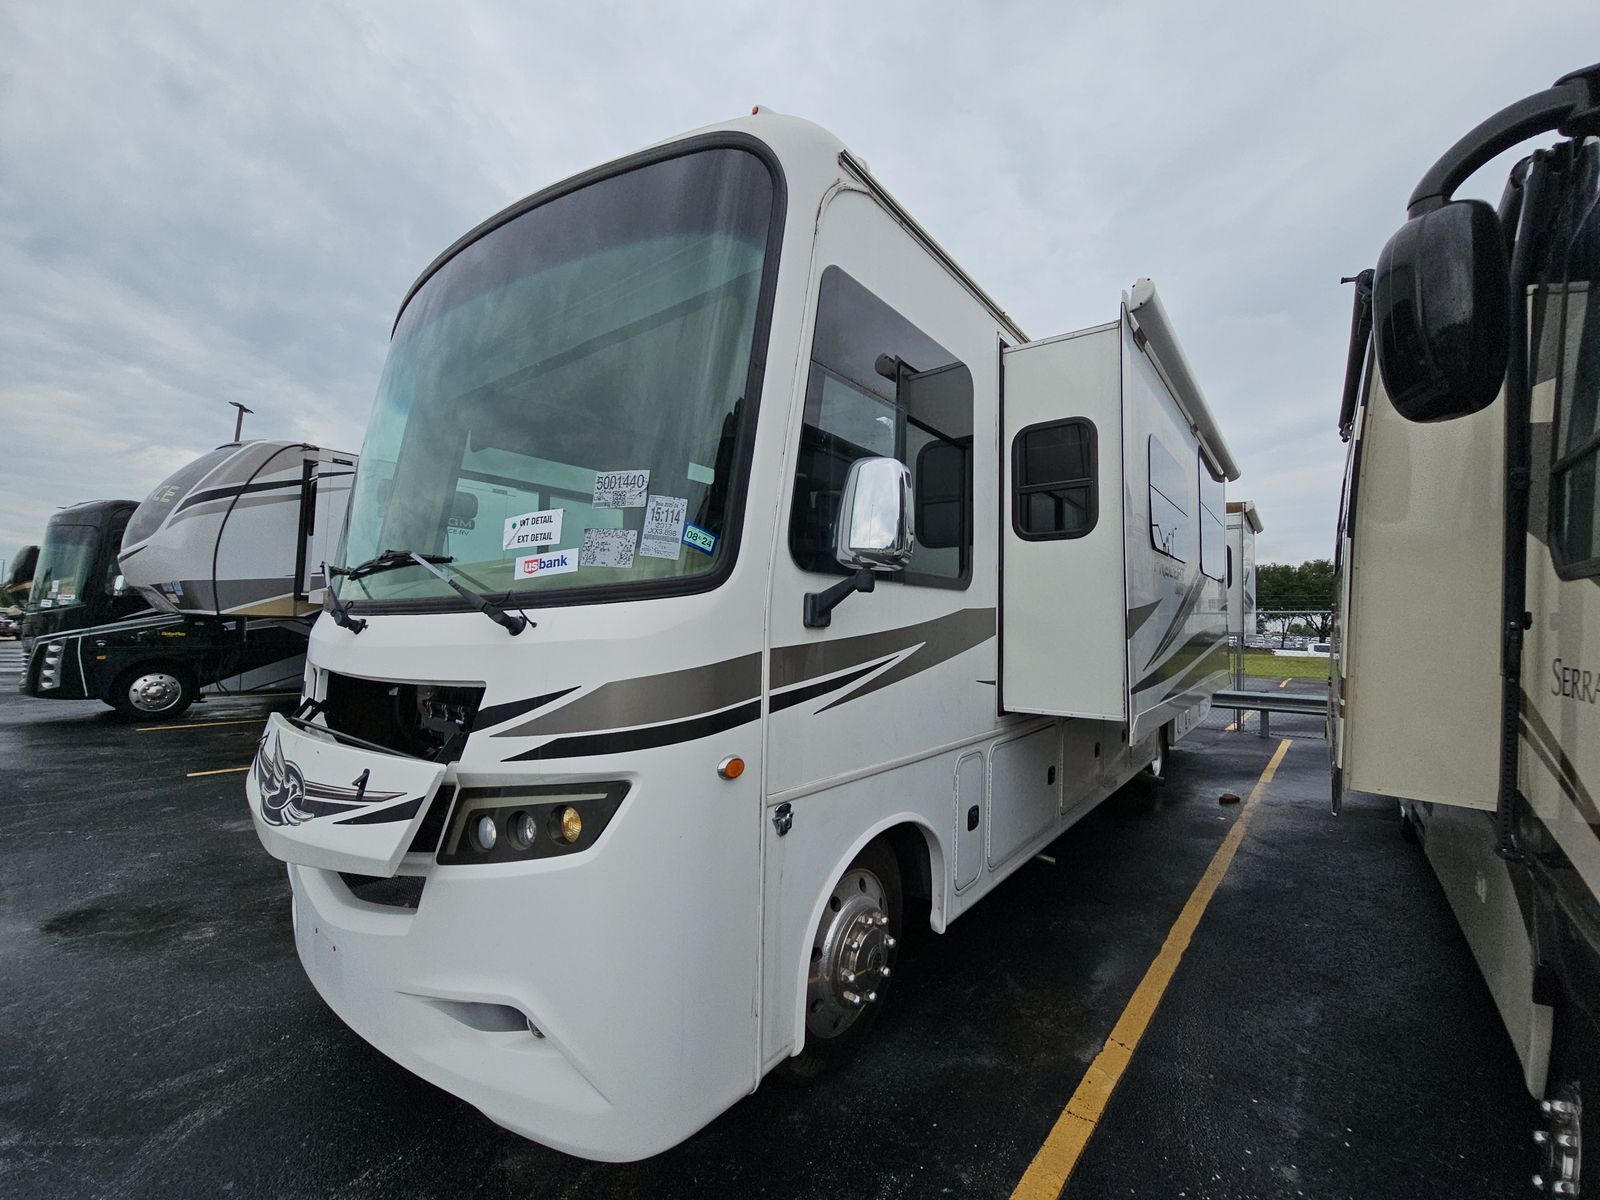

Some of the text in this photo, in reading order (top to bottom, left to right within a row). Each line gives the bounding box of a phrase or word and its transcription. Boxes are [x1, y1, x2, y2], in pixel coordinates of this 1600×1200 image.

[596, 474, 645, 490] 5001440
[531, 515, 554, 526] DETAIL
[517, 532, 553, 544] EXT DETAIL
